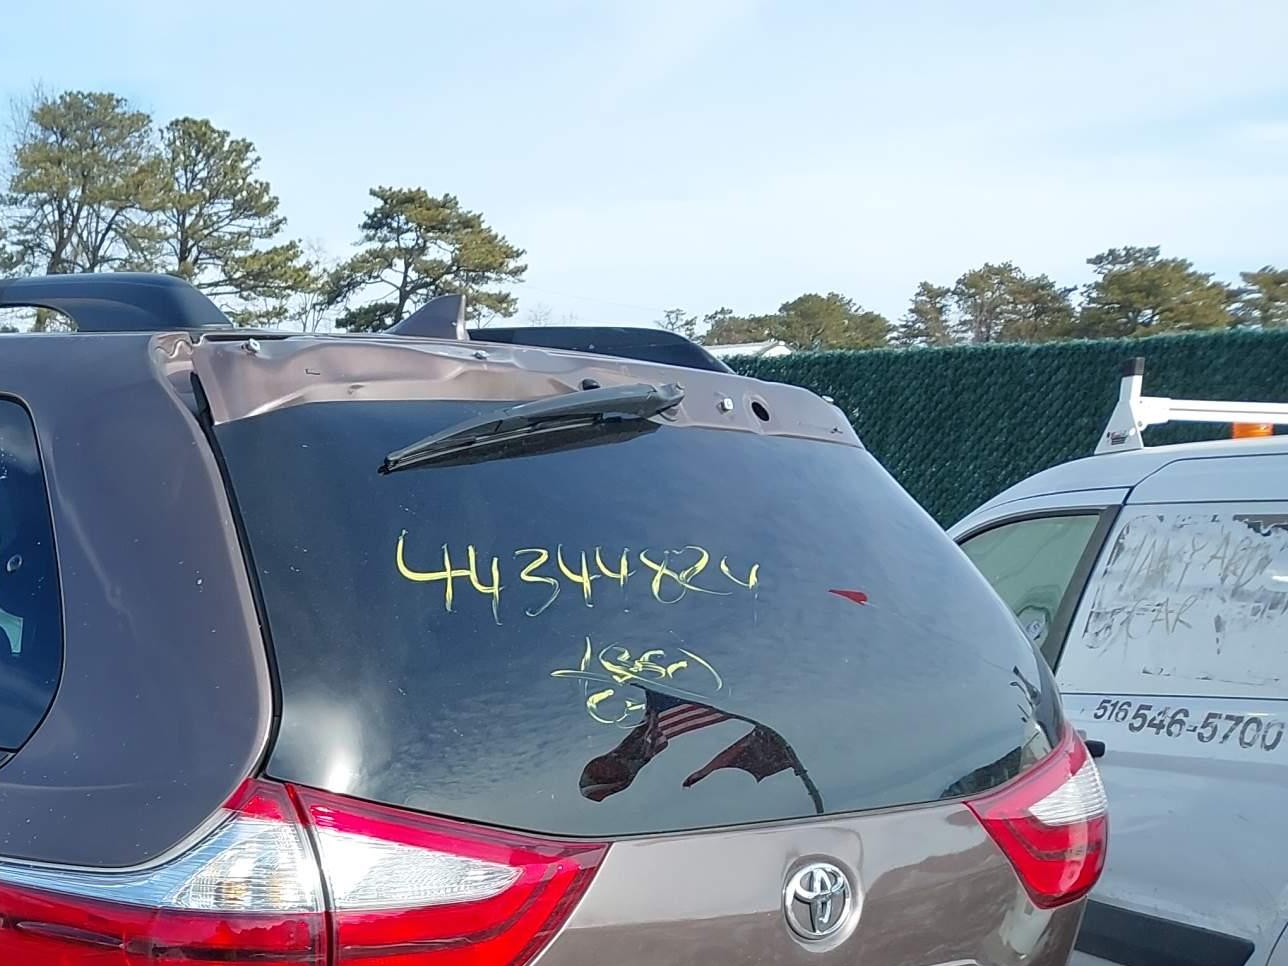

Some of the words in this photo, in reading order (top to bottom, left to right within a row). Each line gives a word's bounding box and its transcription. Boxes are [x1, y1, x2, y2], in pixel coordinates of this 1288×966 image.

[397, 530, 760, 625] 44344824
[1093, 699, 1132, 722] 516
[1128, 704, 1284, 751] 546-5700
